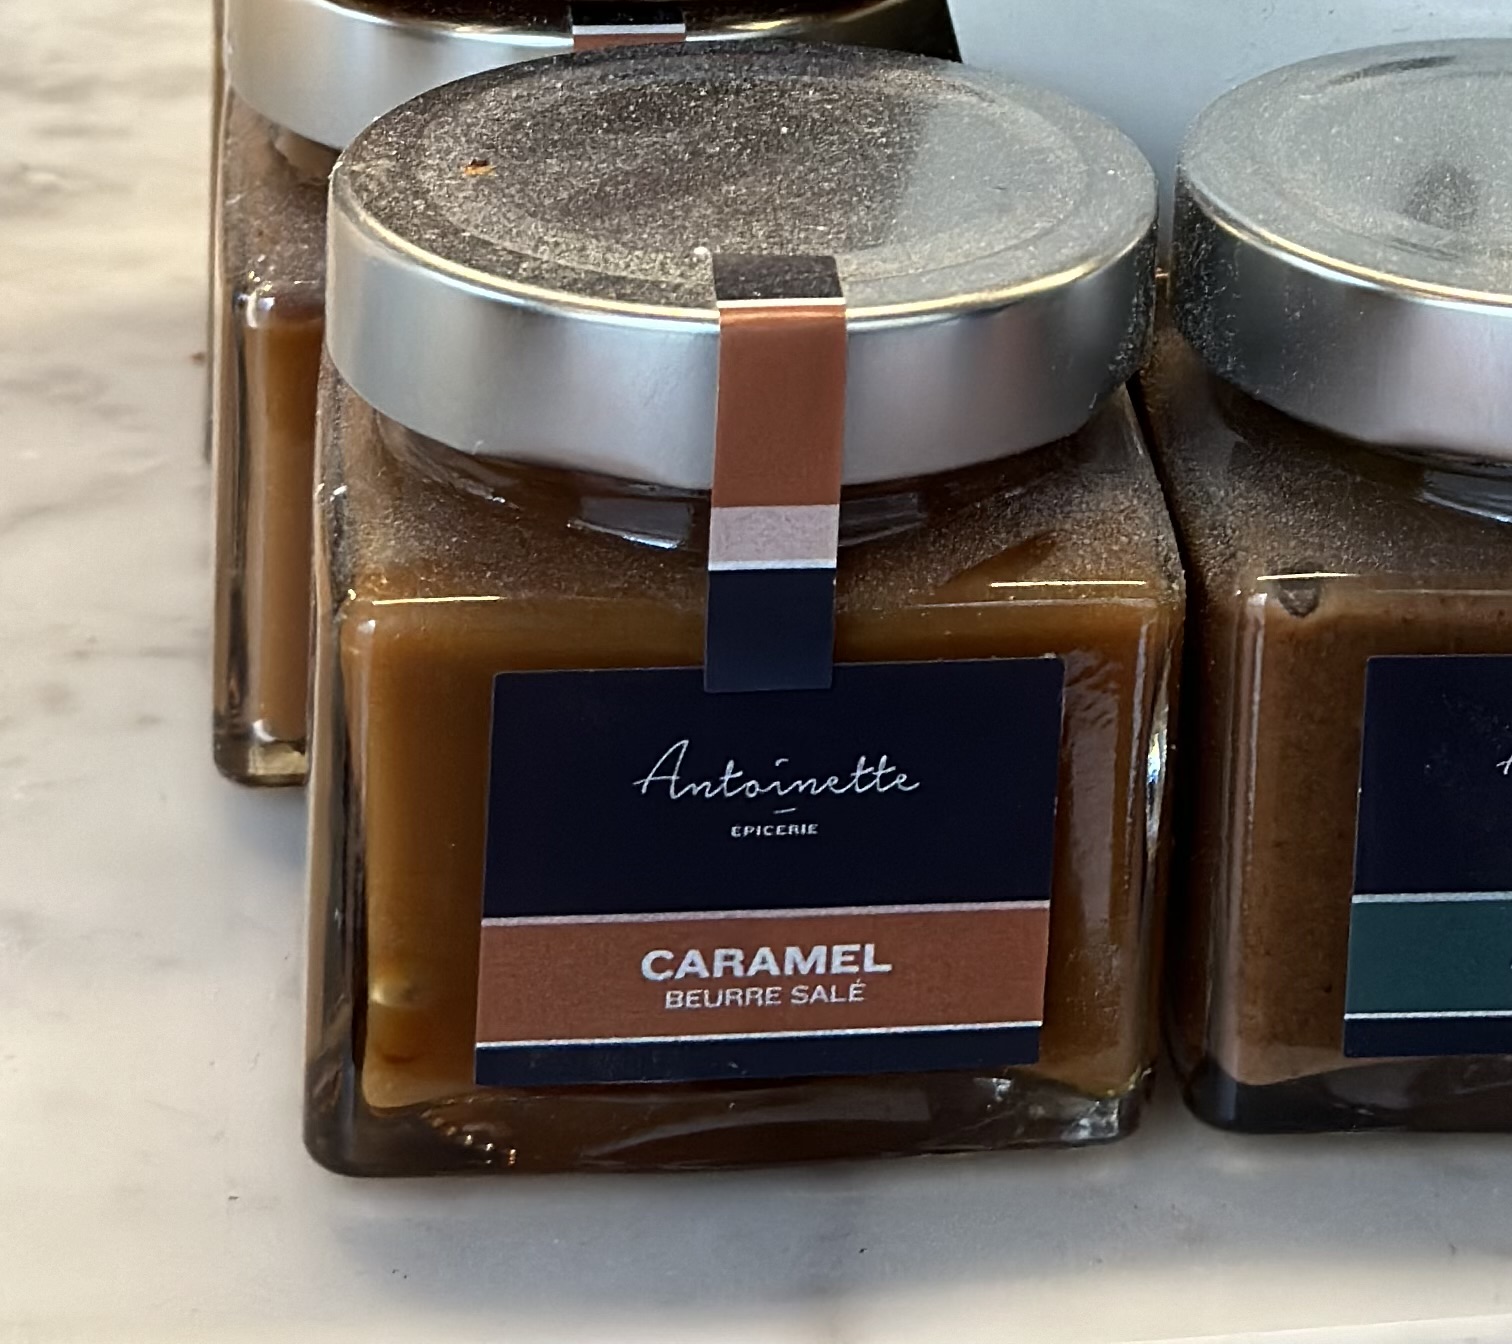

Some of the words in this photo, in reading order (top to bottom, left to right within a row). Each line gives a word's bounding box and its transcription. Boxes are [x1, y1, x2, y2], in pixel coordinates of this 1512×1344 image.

[633, 739, 919, 800] Antoinette
[640, 943, 893, 982] CARAMEL
[664, 985, 782, 1010] BEURRE
[790, 978, 866, 1005] SALÉ
